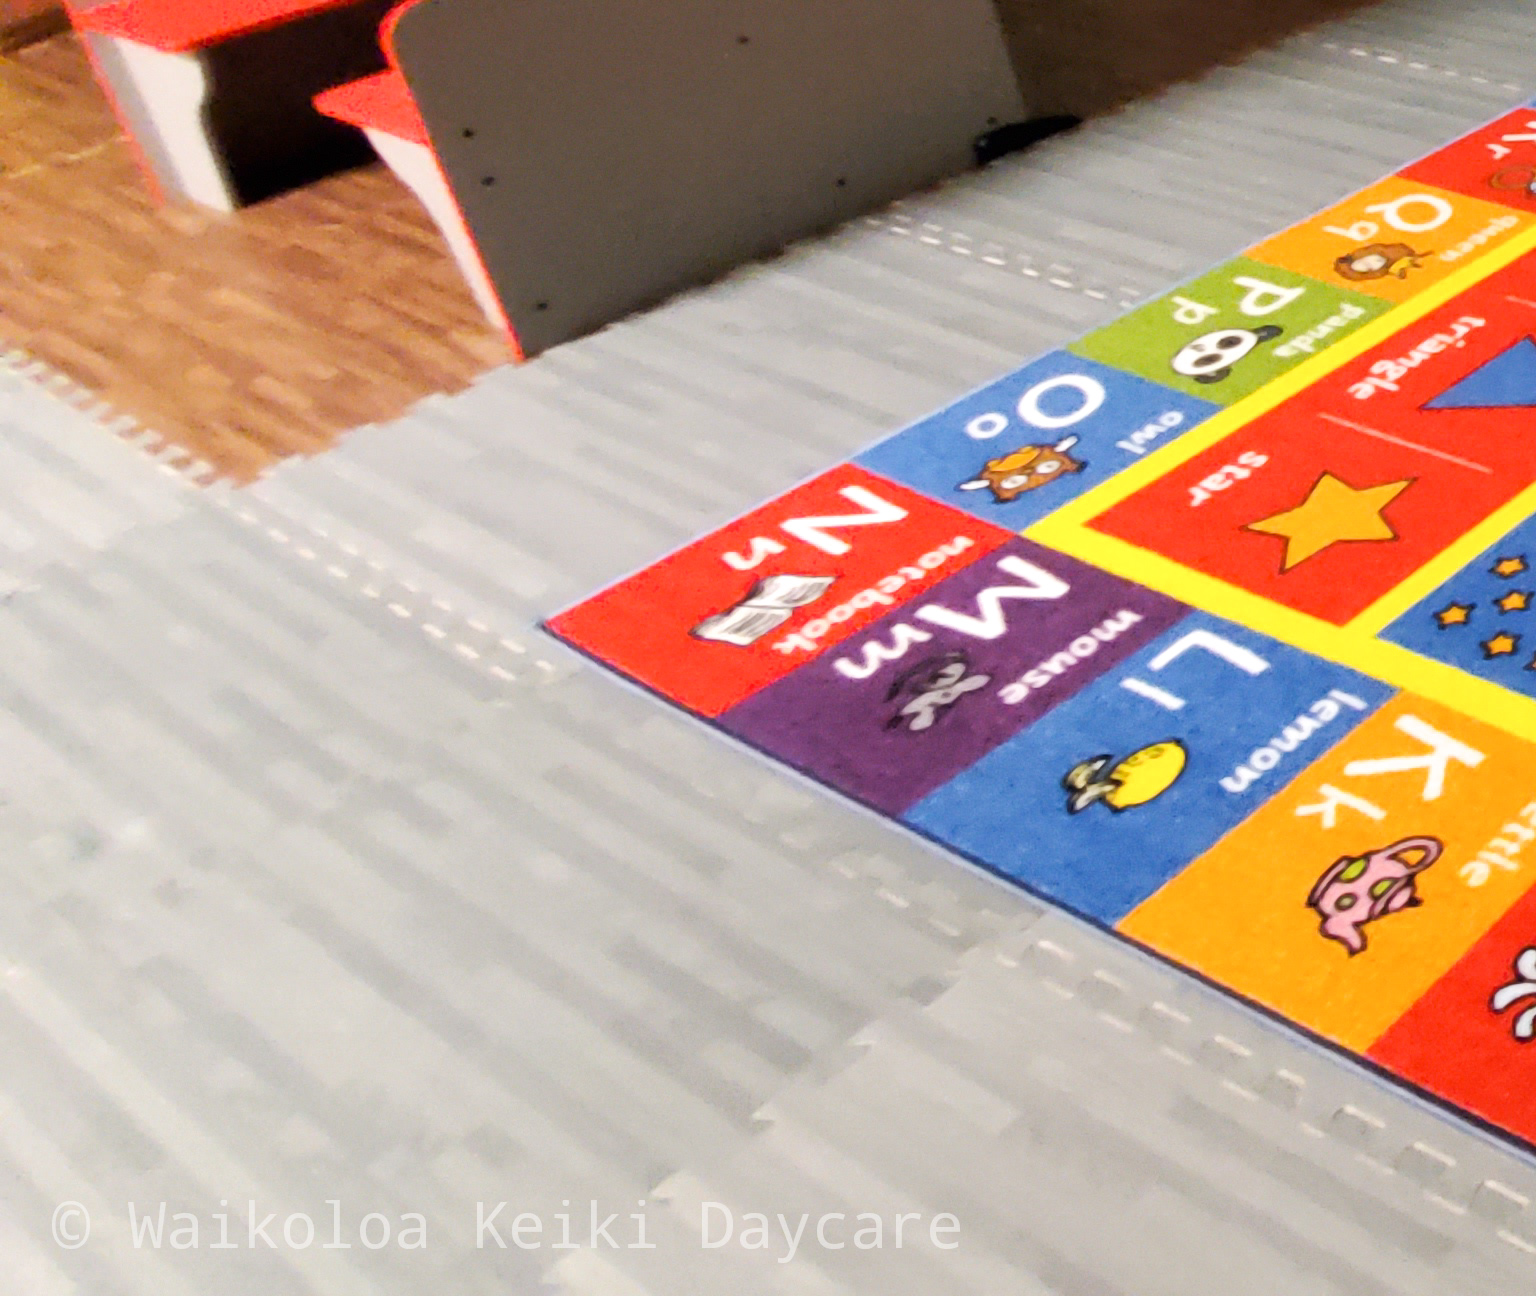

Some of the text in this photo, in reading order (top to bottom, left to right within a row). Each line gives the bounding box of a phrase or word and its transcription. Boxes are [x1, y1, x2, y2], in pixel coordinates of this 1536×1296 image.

[1270, 302, 1367, 360] panda
[1346, 315, 1488, 402] triangle
[1113, 408, 1186, 458] owl
[1186, 449, 1271, 509] star
[769, 533, 977, 658] notebook
[995, 606, 1146, 707] mouse
[1215, 686, 1369, 796] lemon
